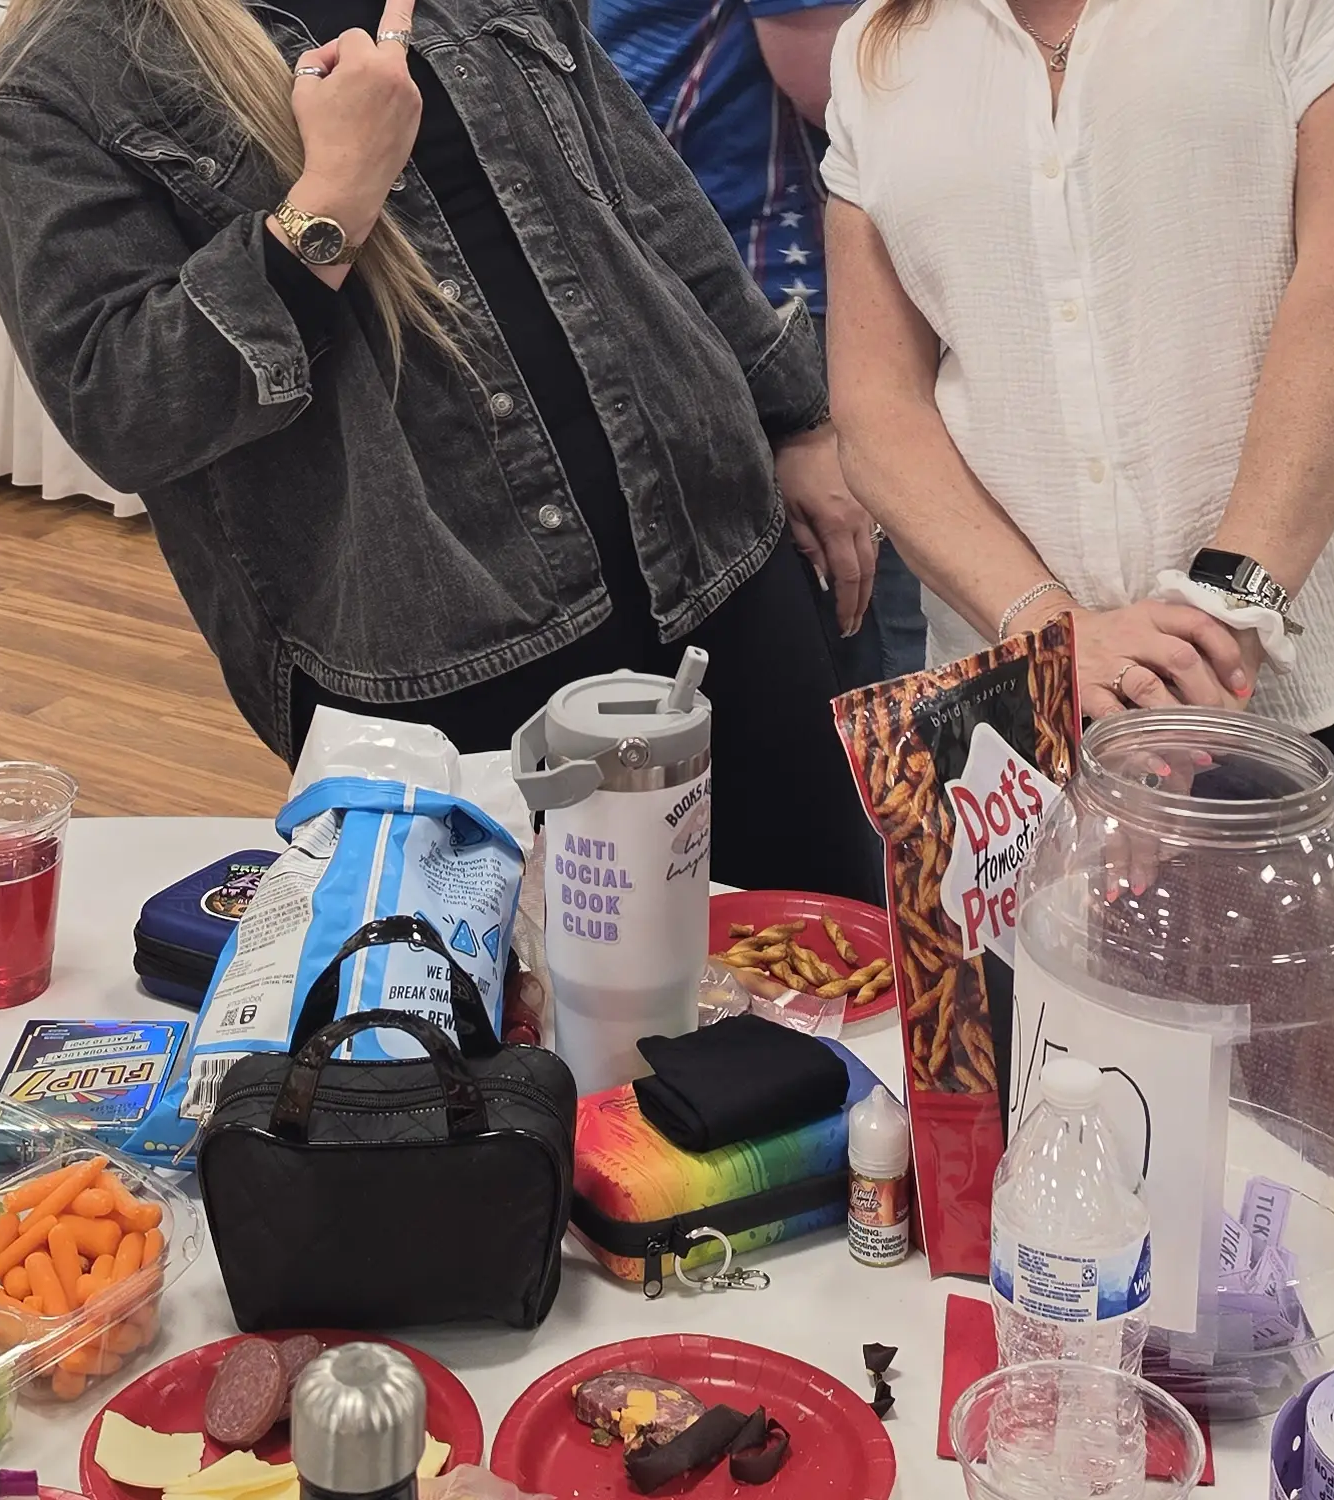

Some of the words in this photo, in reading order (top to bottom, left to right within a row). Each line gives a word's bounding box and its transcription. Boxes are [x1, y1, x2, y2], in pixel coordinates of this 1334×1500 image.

[930, 703, 962, 728] bold
[975, 677, 1017, 704] savory
[664, 782, 703, 828] BOOKS
[951, 758, 1044, 856] Dot's
[457, 857, 488, 867] flavors
[489, 857, 502, 867] are
[564, 833, 615, 862] ANTI
[445, 869, 461, 879] this
[463, 871, 484, 879] bold
[452, 877, 479, 886] flavor
[555, 853, 633, 889] SOCIAL
[442, 898, 468, 906] thank
[444, 892, 467, 900] taste
[468, 895, 489, 907] buds
[562, 884, 621, 915] BOOK
[563, 911, 619, 941] CLUB
[427, 965, 444, 980] WE
[389, 986, 427, 1000] BREAK
[429, 988, 451, 1004] SNA
[1252, 1195, 1275, 1243] TICK
[1219, 1223, 1241, 1271] TICKE
